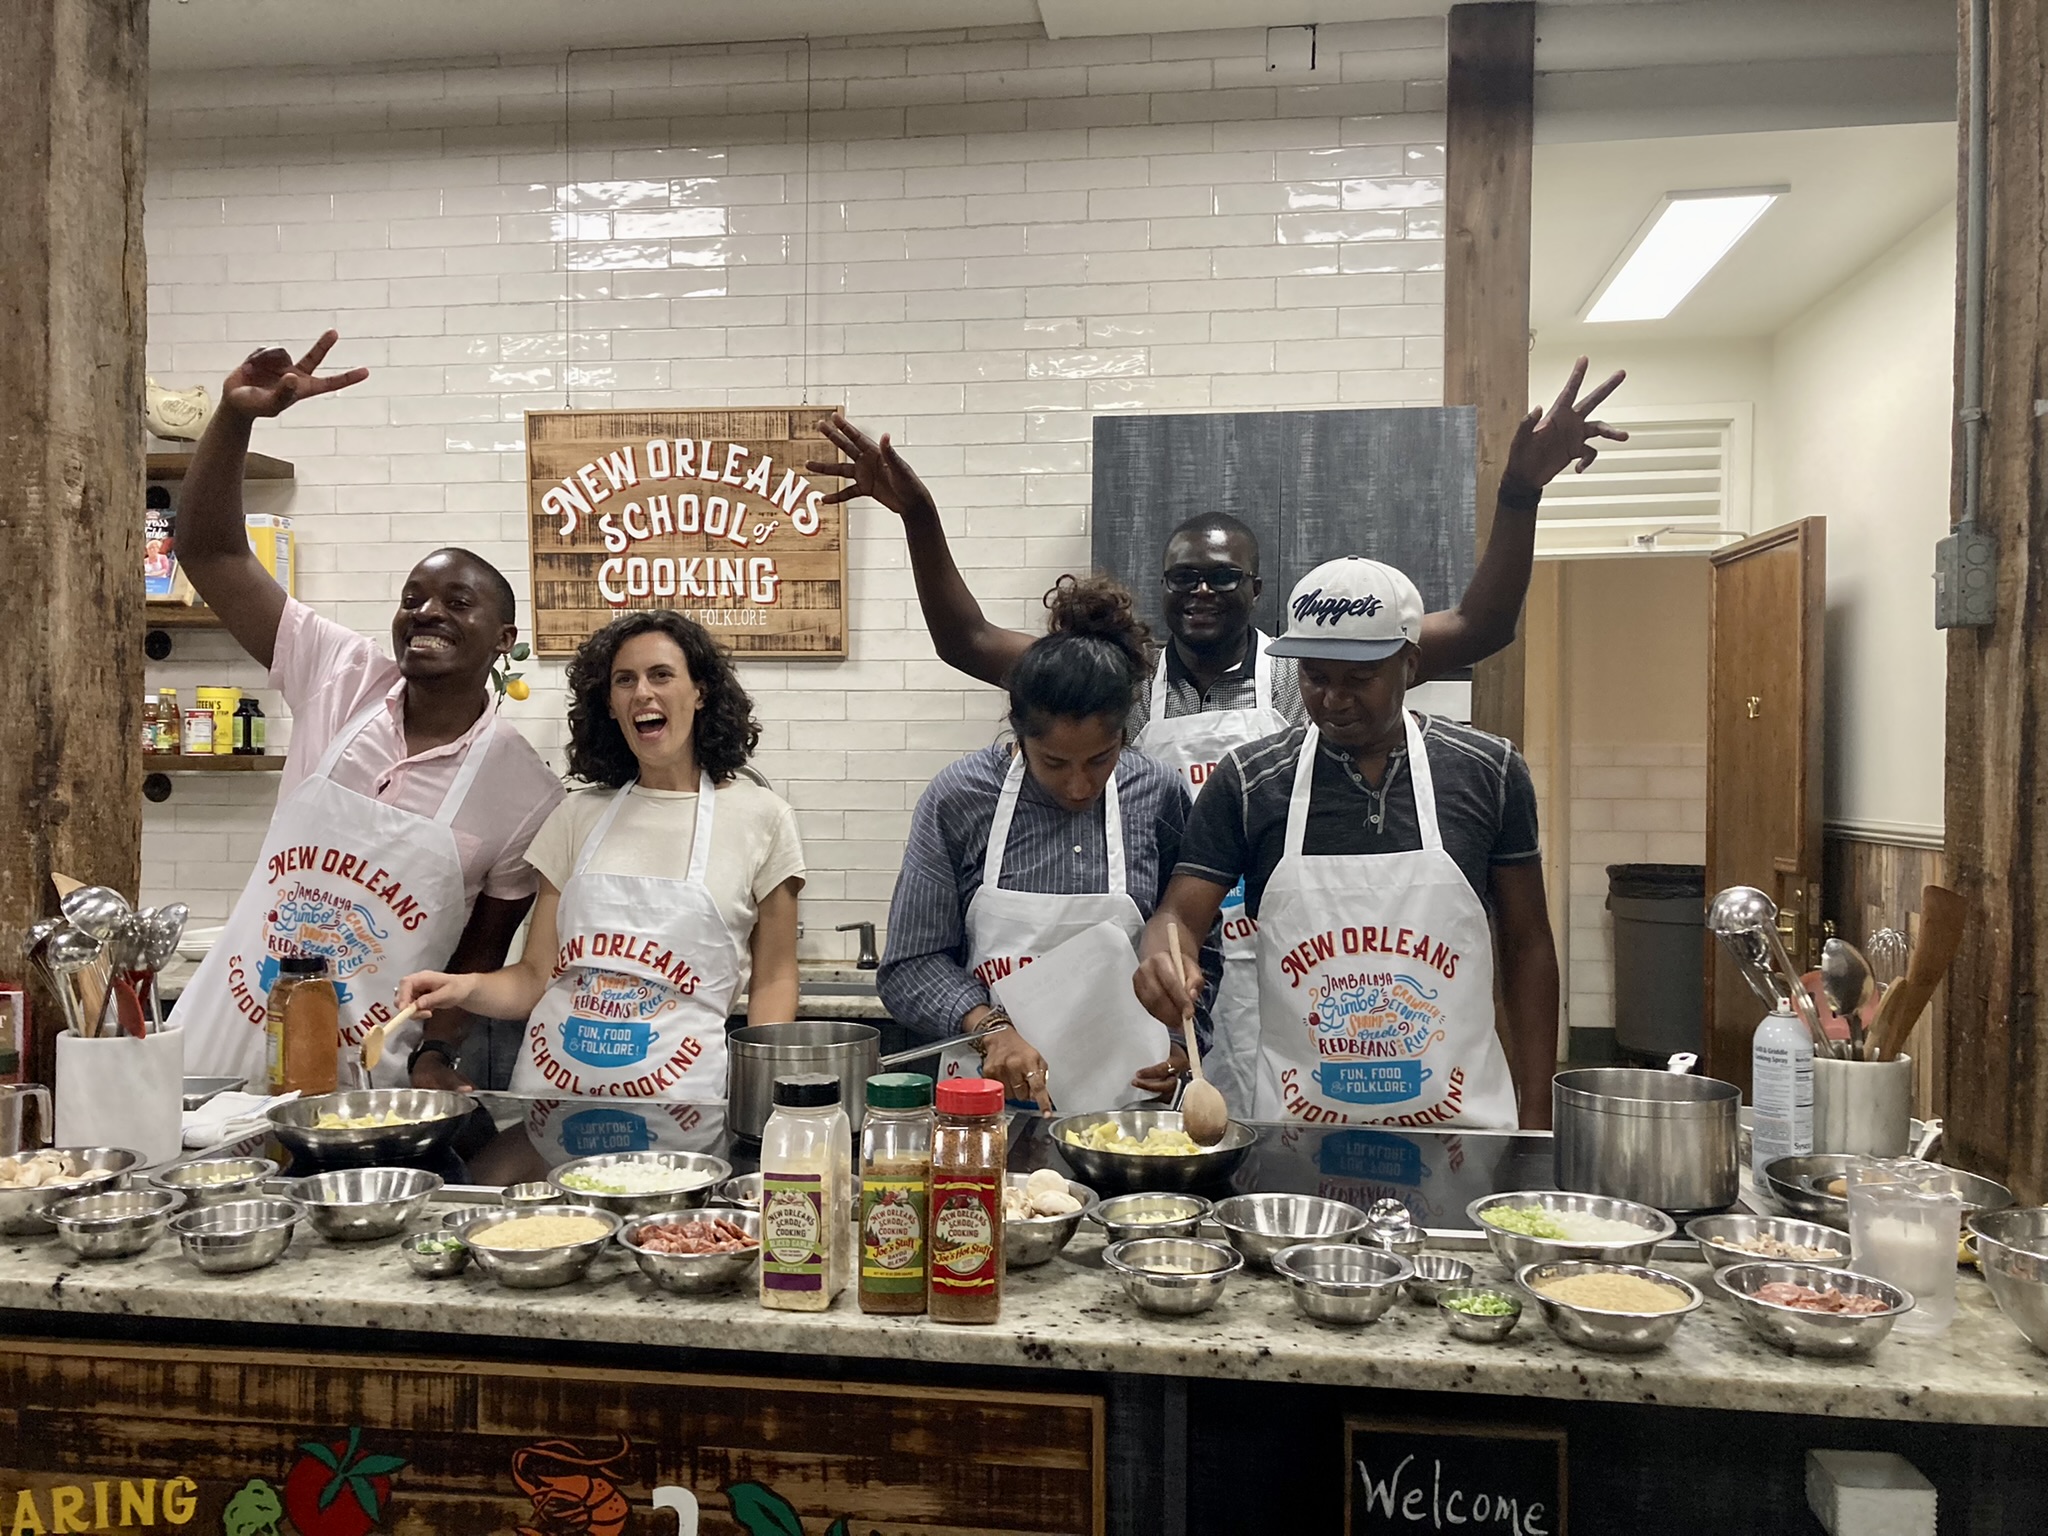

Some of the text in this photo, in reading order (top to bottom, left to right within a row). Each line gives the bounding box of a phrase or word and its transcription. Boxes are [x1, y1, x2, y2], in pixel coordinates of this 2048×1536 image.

[541, 438, 826, 536] NEW ORLEANS
[598, 494, 779, 553] SCHOOL of
[598, 557, 780, 604] COOKING
[700, 609, 767, 626] FOLKLORE
[1293, 588, 1383, 626] Nuggets
[268, 846, 428, 931] NEW ORLEANS
[287, 881, 352, 911] JAMBALAYA
[274, 902, 334, 932] Gumbo
[337, 954, 363, 975] RICE
[551, 933, 701, 996] NEW ORLEANS
[1281, 926, 1460, 988] NEW ORLEANS
[1320, 972, 1393, 998] JAMBALAYA
[229, 955, 267, 1032] SCHOO
[337, 1002, 391, 1048] KING
[639, 993, 664, 1016] RICE
[1317, 986, 1379, 1033] Gumbo
[1388, 999, 1431, 1025] ETOUFFEE
[1392, 984, 1440, 1018] CRAWFISH
[603, 1028, 632, 1041] FOOD
[1403, 1025, 1431, 1053] RICE
[530, 1022, 703, 1097] SCHOOL of COOKING
[581, 1040, 639, 1056] FOLKLORE!
[1371, 1067, 1402, 1079] FOOD
[1347, 1081, 1412, 1093] FOLKLORE!
[768, 1208, 815, 1226] NEW ORLEANS
[776, 1218, 802, 1228] SCHOOL
[870, 1208, 917, 1225] NEW ORLEANS
[879, 1217, 903, 1227] SCHOOL
[940, 1210, 987, 1227] NEW ORLEANS
[949, 1219, 974, 1229] SCHOOL
[776, 1229, 806, 1238] COOKING
[878, 1227, 908, 1236] COOKING
[948, 1229, 979, 1238] COOKING
[872, 1243, 894, 1258] Joe's
[936, 1252, 955, 1263] Joe's
[955, 1247, 970, 1259] Hot
[0, 1474, 198, 1536] ARING
[1356, 1454, 1548, 1536] Welcome
